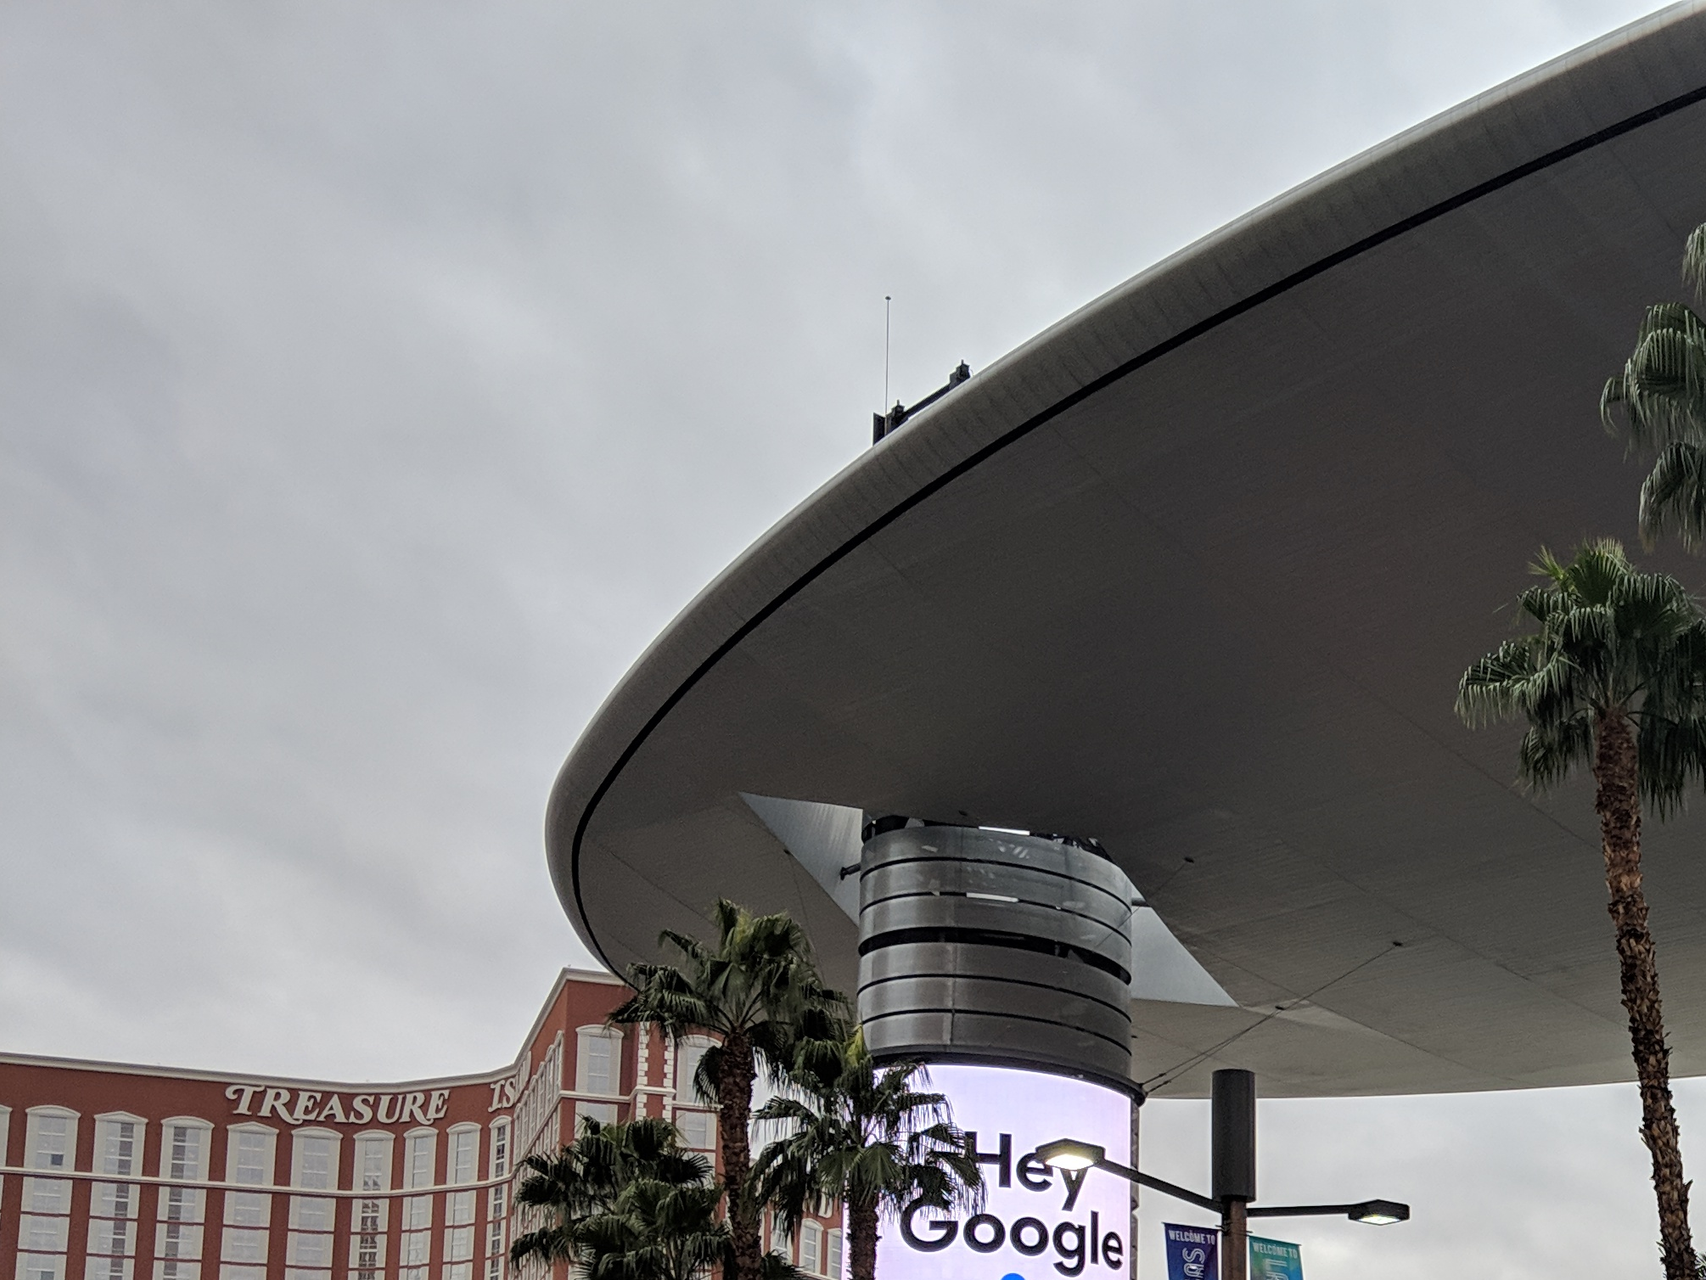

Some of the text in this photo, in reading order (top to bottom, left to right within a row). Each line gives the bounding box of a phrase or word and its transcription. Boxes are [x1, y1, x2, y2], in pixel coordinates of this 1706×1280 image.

[225, 1083, 451, 1126] TREASURE
[964, 1131, 1090, 1211] Hey
[900, 1192, 1123, 1277] Google
[1168, 1229, 1216, 1246] WELCOME TO
[1252, 1241, 1298, 1259] WELCOME TO
